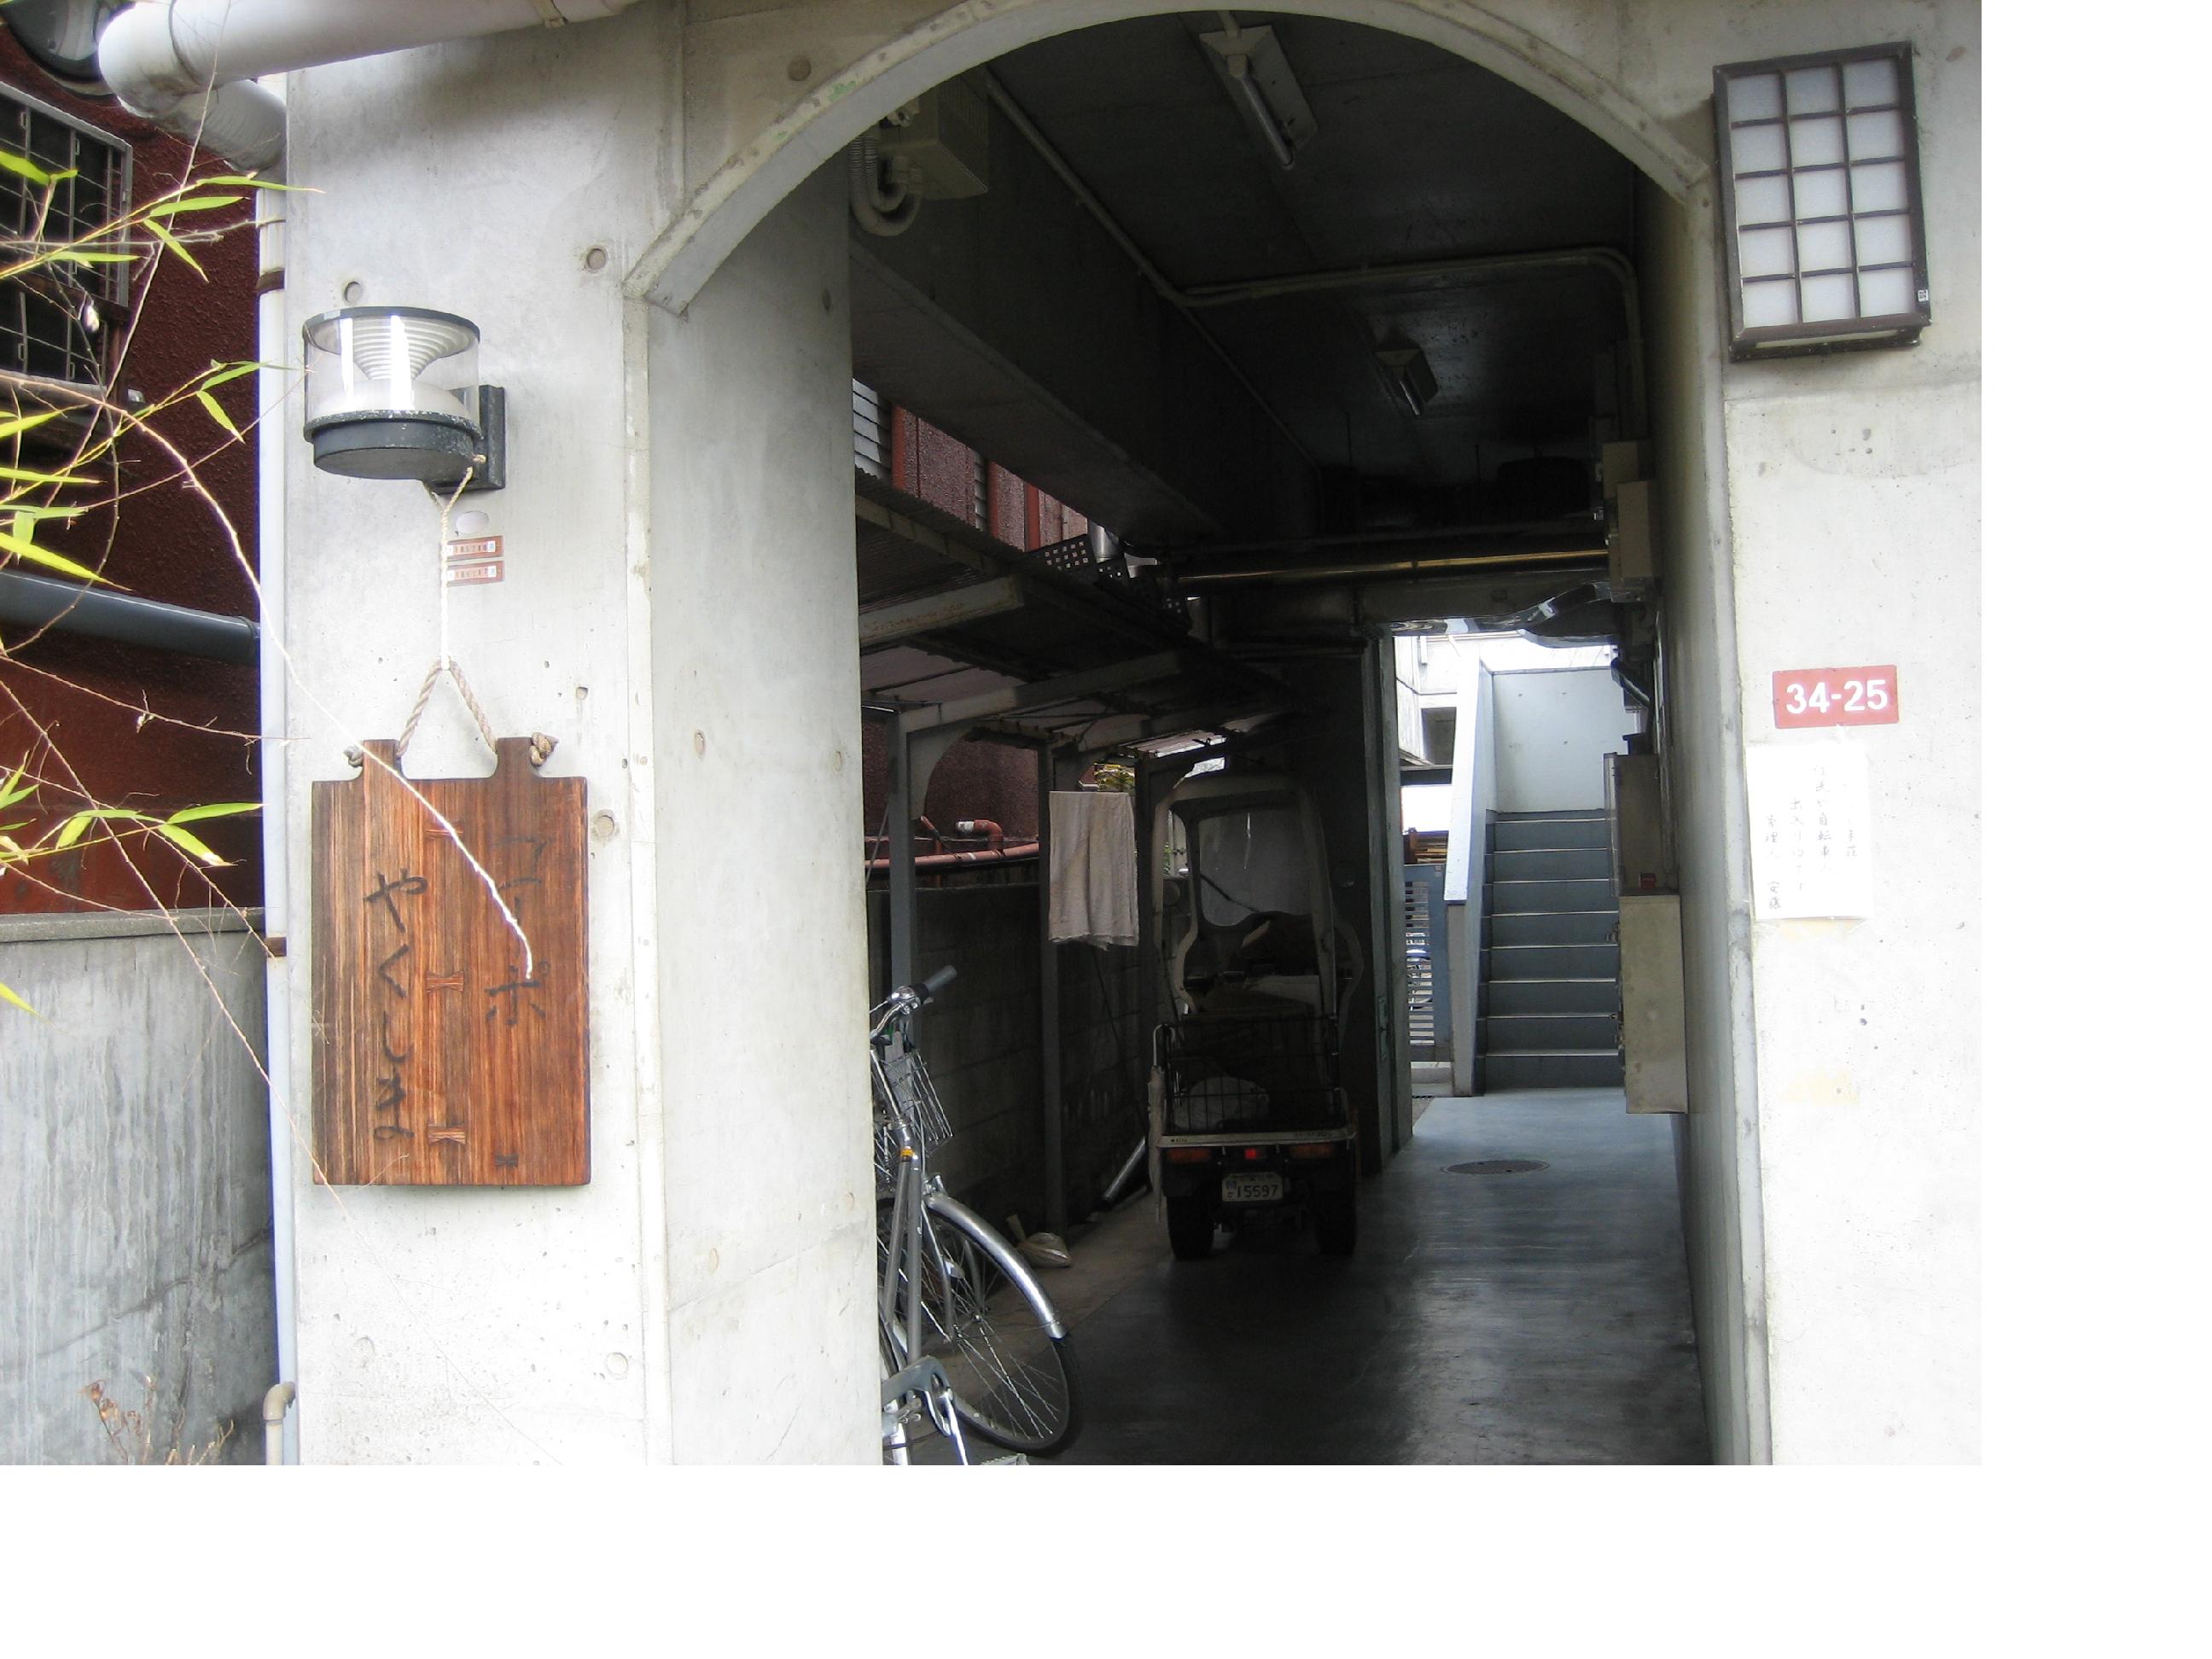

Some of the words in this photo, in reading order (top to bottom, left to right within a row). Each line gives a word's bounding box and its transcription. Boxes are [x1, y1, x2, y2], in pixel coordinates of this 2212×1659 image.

[1785, 679, 1889, 715] 34-25
[364, 867, 428, 1141] やくしま
[1237, 1184, 1278, 1198] 15597
